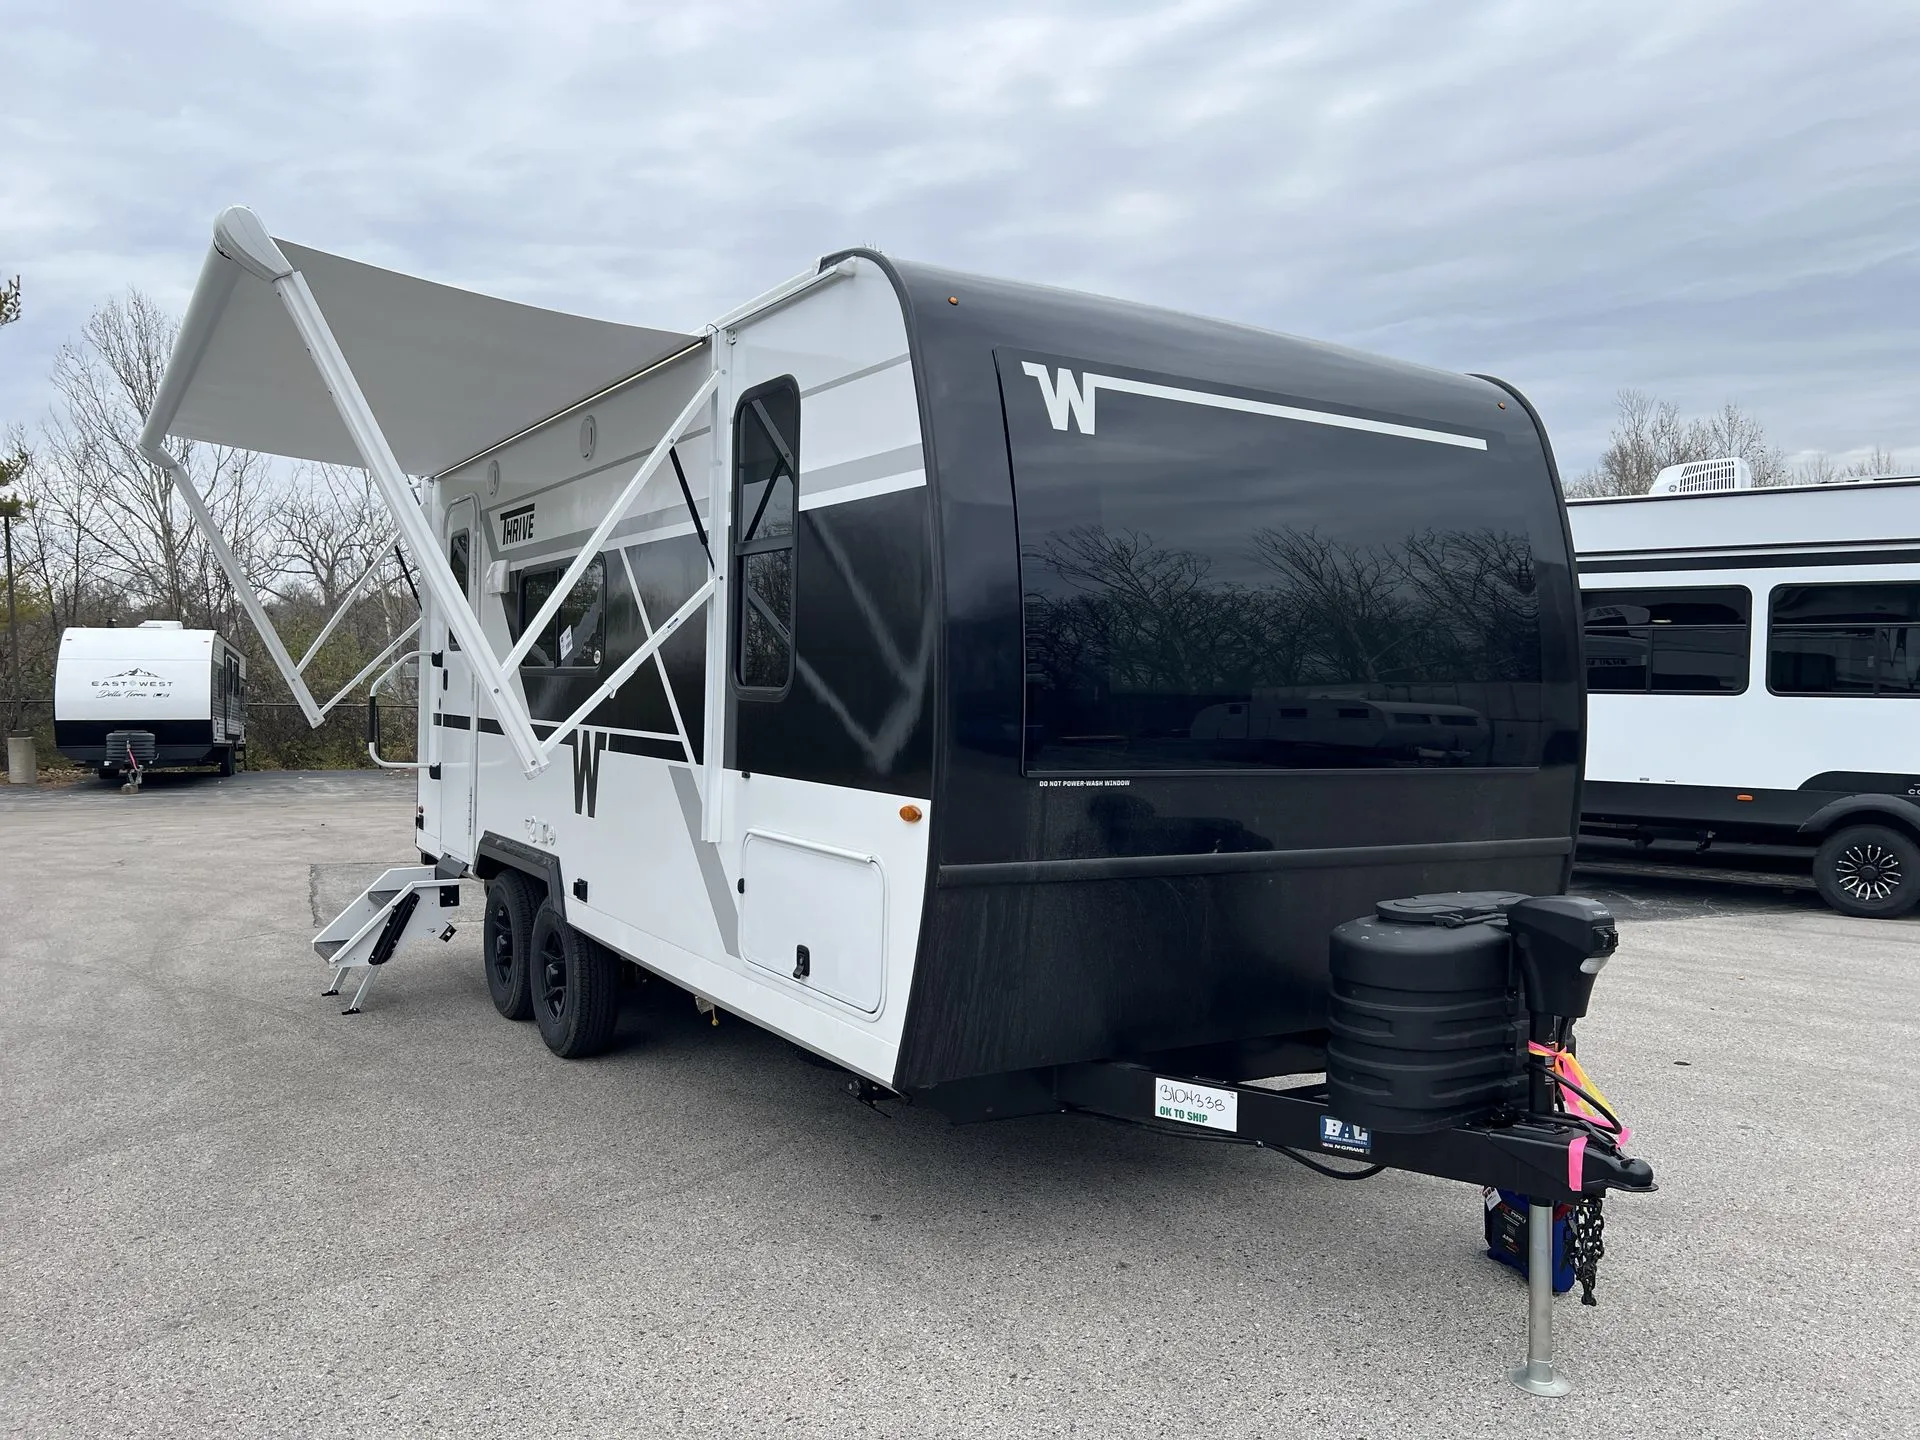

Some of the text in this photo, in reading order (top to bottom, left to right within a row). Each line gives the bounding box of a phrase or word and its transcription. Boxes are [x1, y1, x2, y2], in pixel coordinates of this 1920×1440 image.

[1021, 361, 1096, 435] W
[500, 503, 535, 545] THRIVE
[1160, 1106, 1208, 1123] OK TO SHIP
